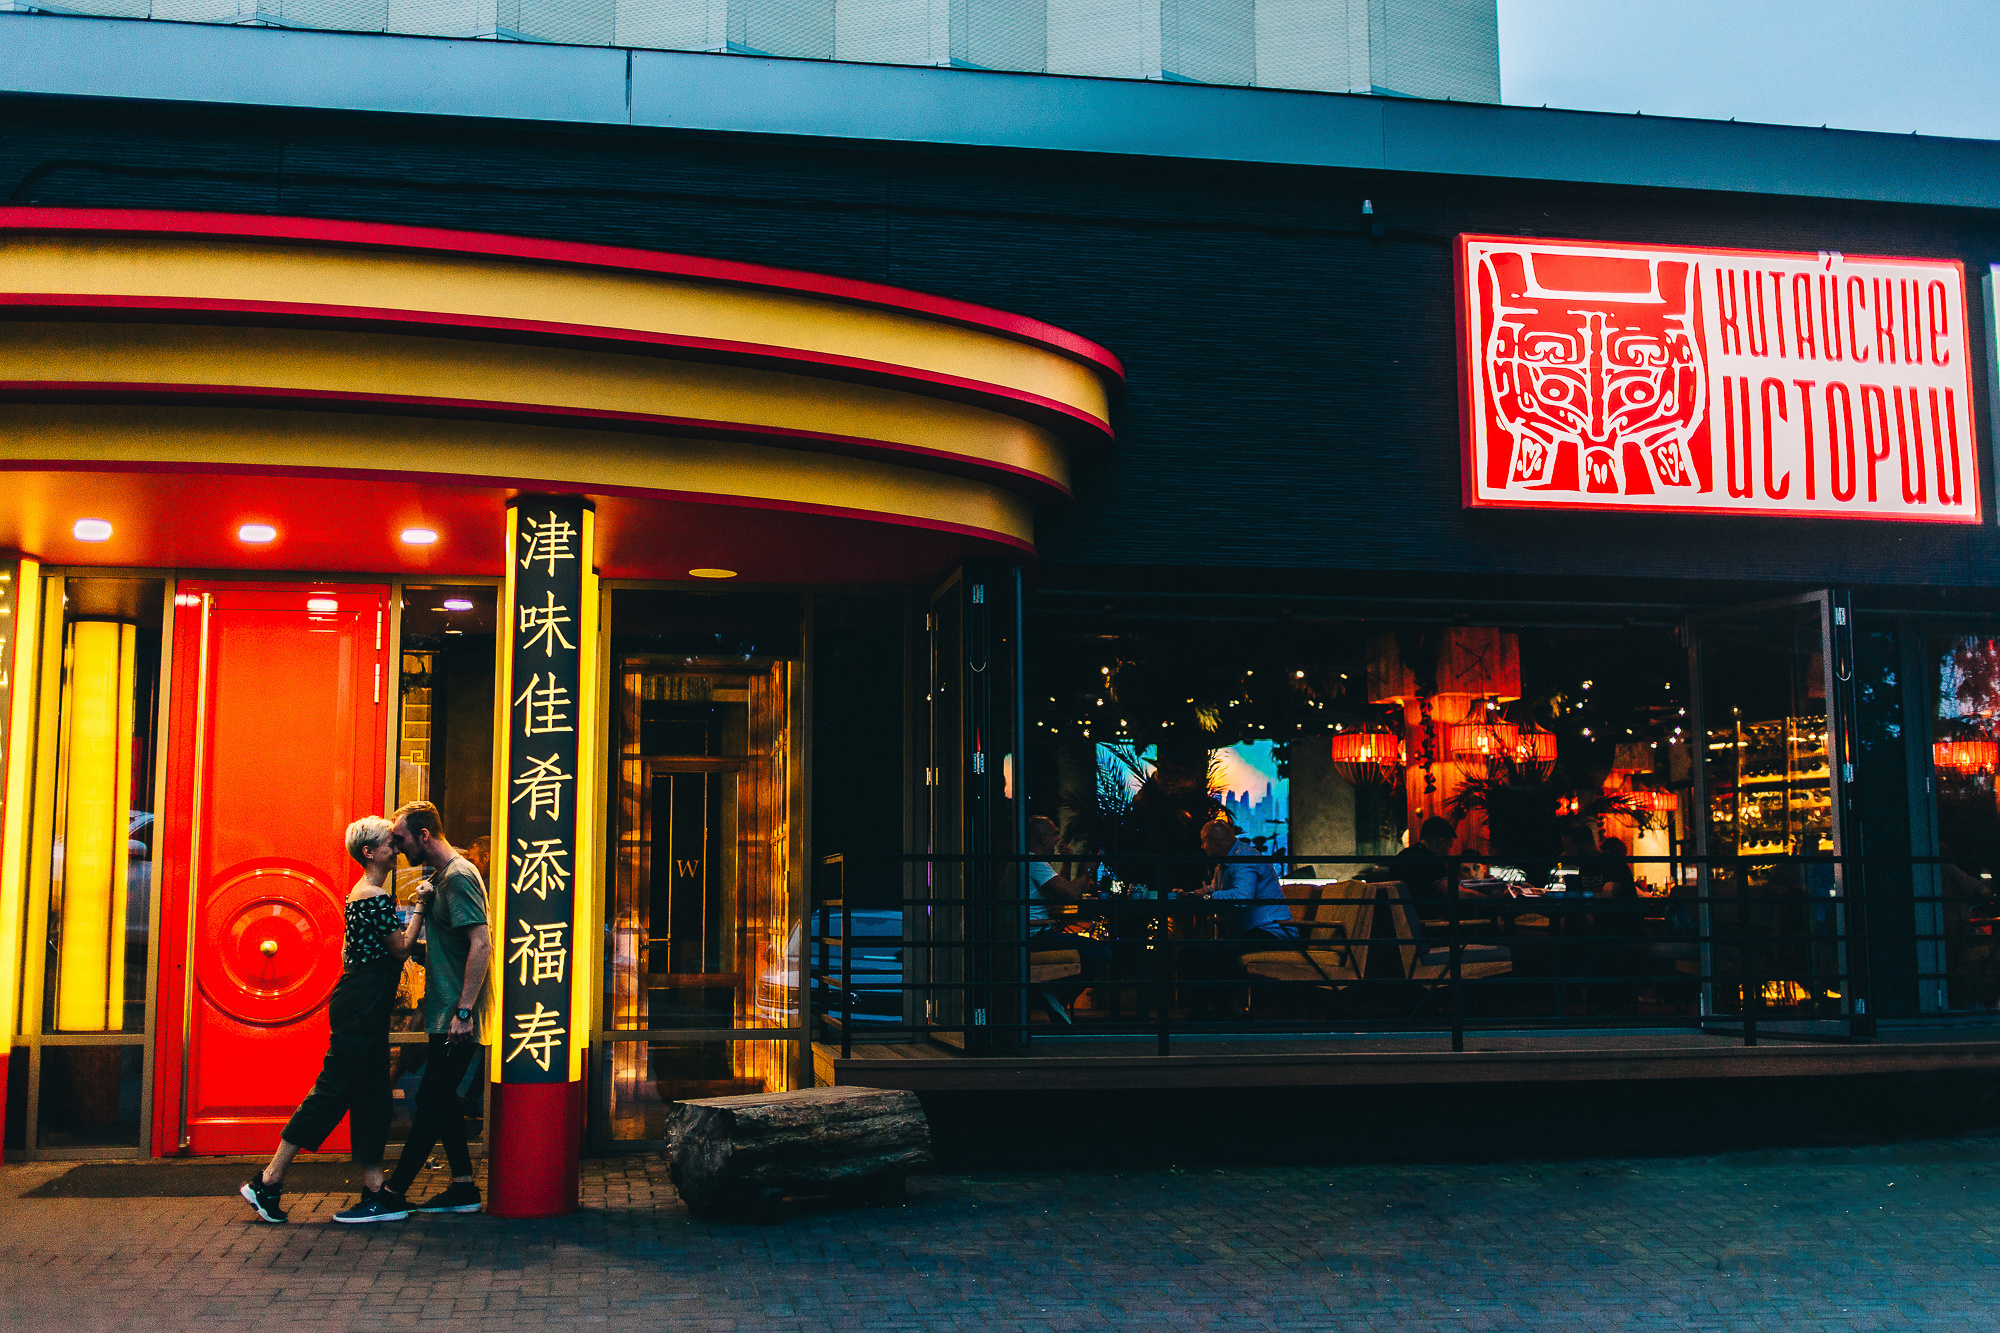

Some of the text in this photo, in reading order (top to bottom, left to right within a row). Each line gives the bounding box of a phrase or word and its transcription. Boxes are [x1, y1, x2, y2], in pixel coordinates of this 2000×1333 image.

[1723, 376, 1963, 507] ИСТОРИИ
[505, 510, 577, 1072] 津味佳肴添福寿
[676, 858, 699, 878] W
